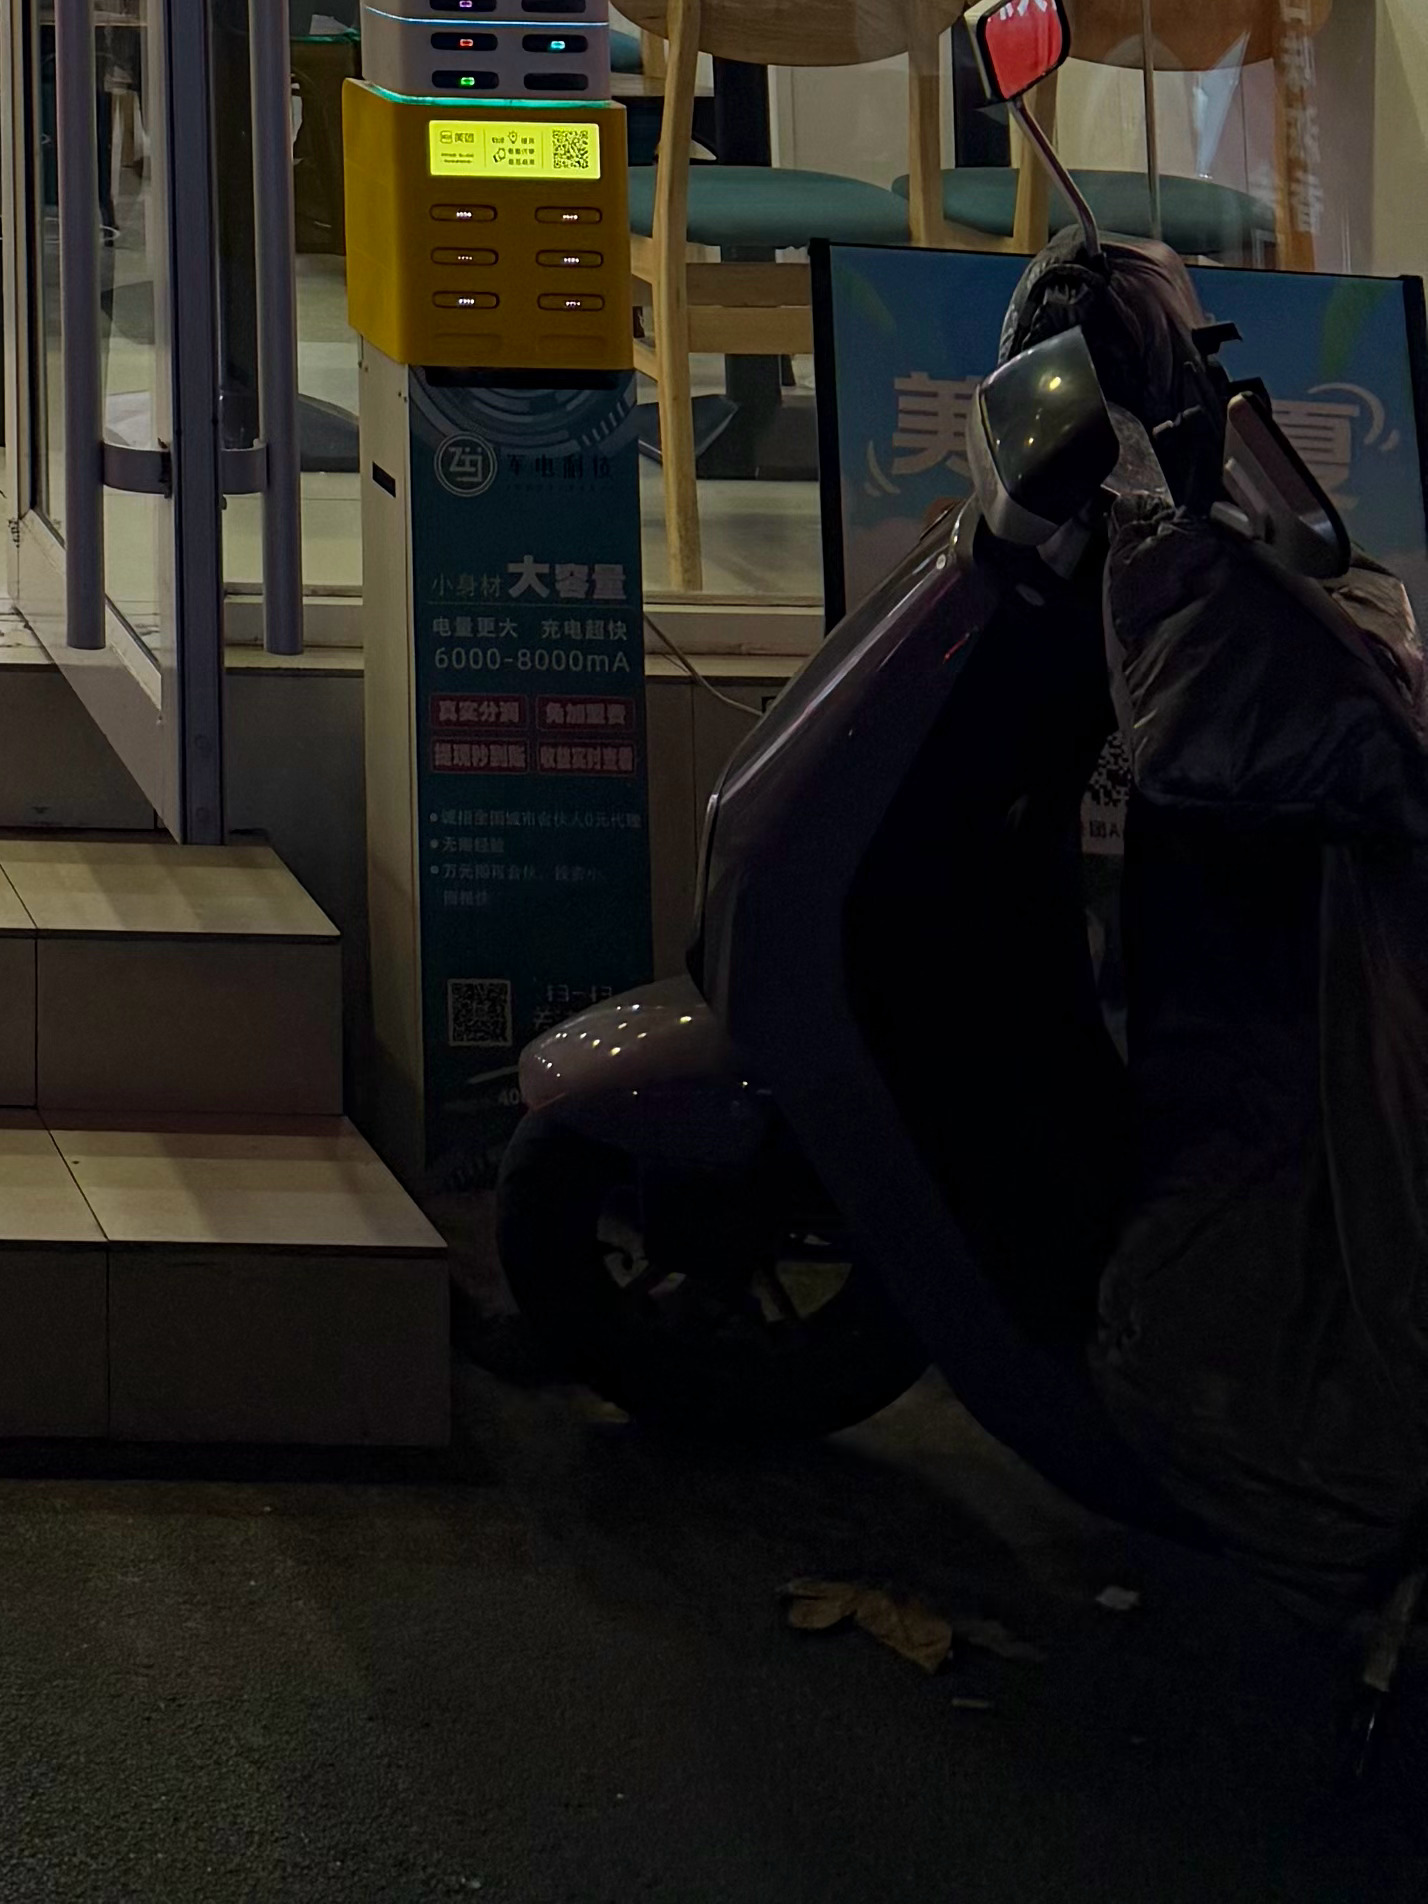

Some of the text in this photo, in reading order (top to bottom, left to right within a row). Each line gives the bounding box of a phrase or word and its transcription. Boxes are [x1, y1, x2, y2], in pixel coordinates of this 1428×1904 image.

[432, 614, 628, 642] 电量更大 充电超快
[433, 646, 632, 674] 6000-8000mA
